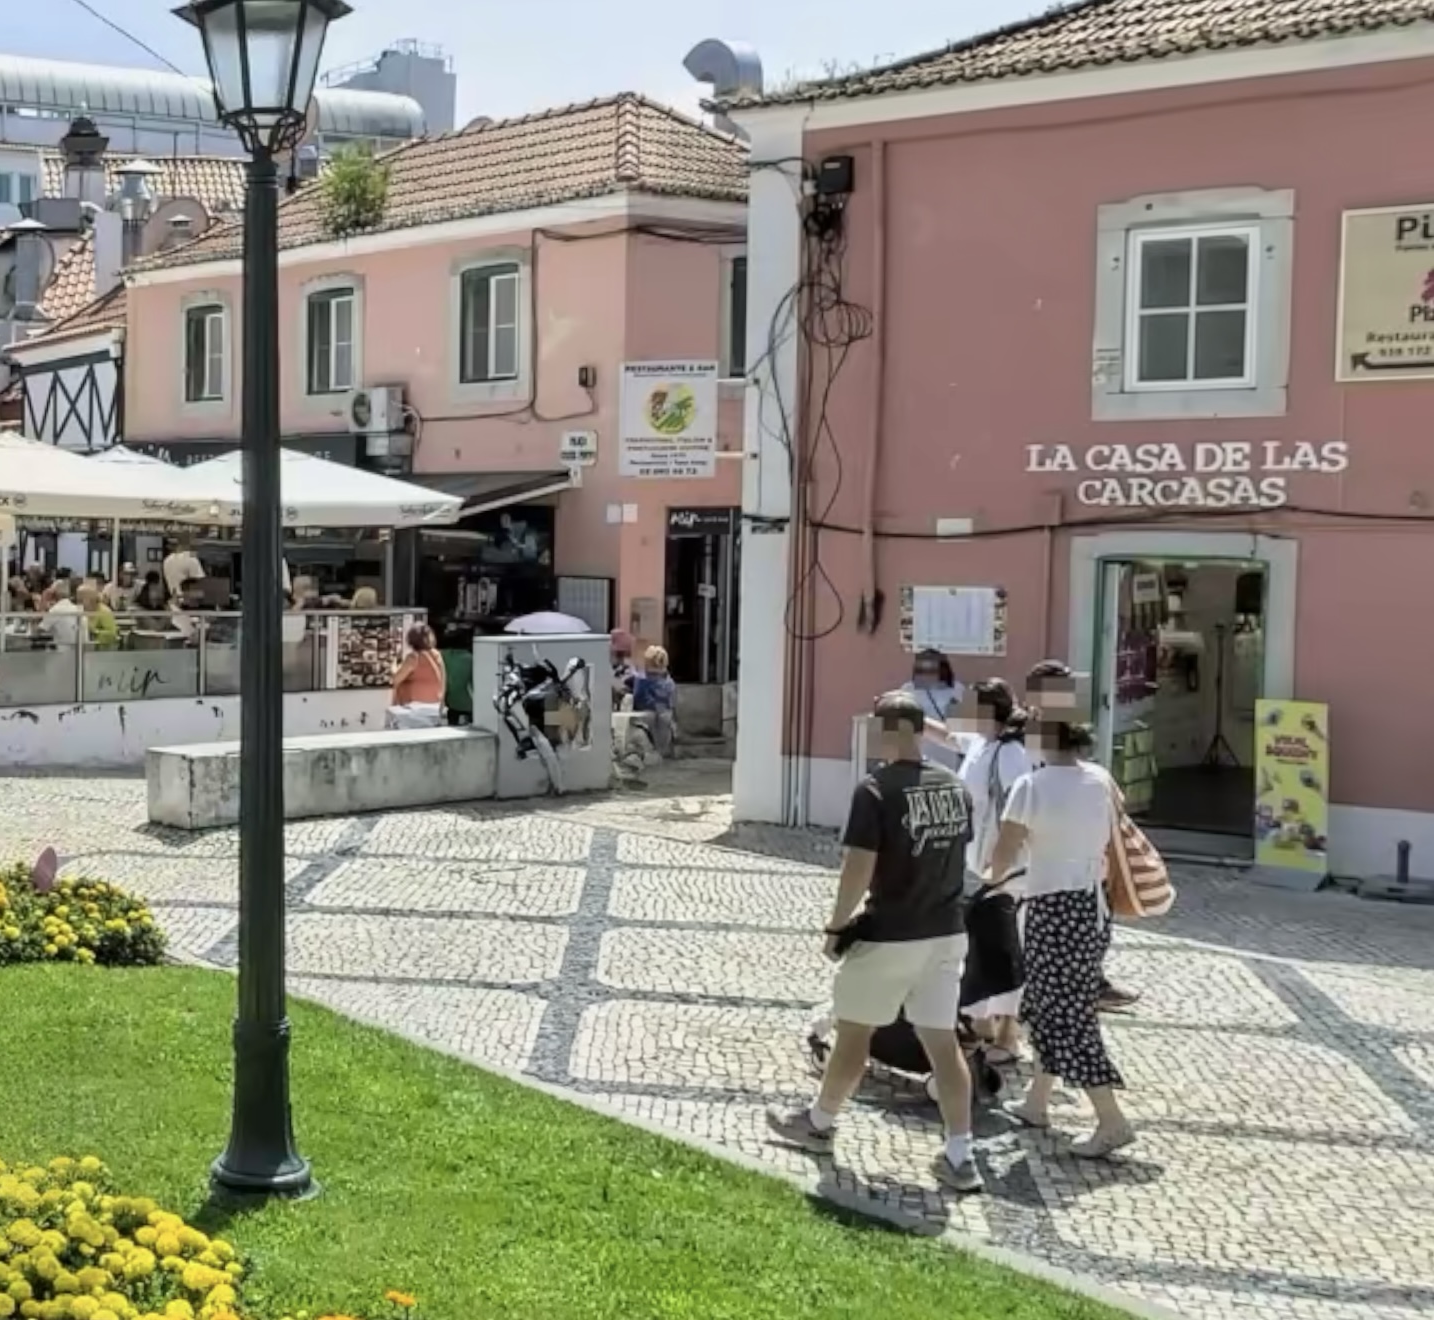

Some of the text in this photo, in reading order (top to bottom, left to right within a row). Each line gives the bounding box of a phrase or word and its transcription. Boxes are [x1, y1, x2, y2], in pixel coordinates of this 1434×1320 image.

[1024, 440, 1348, 473] LA CASA DE LAS
[1077, 475, 1287, 507] CARCASAS
